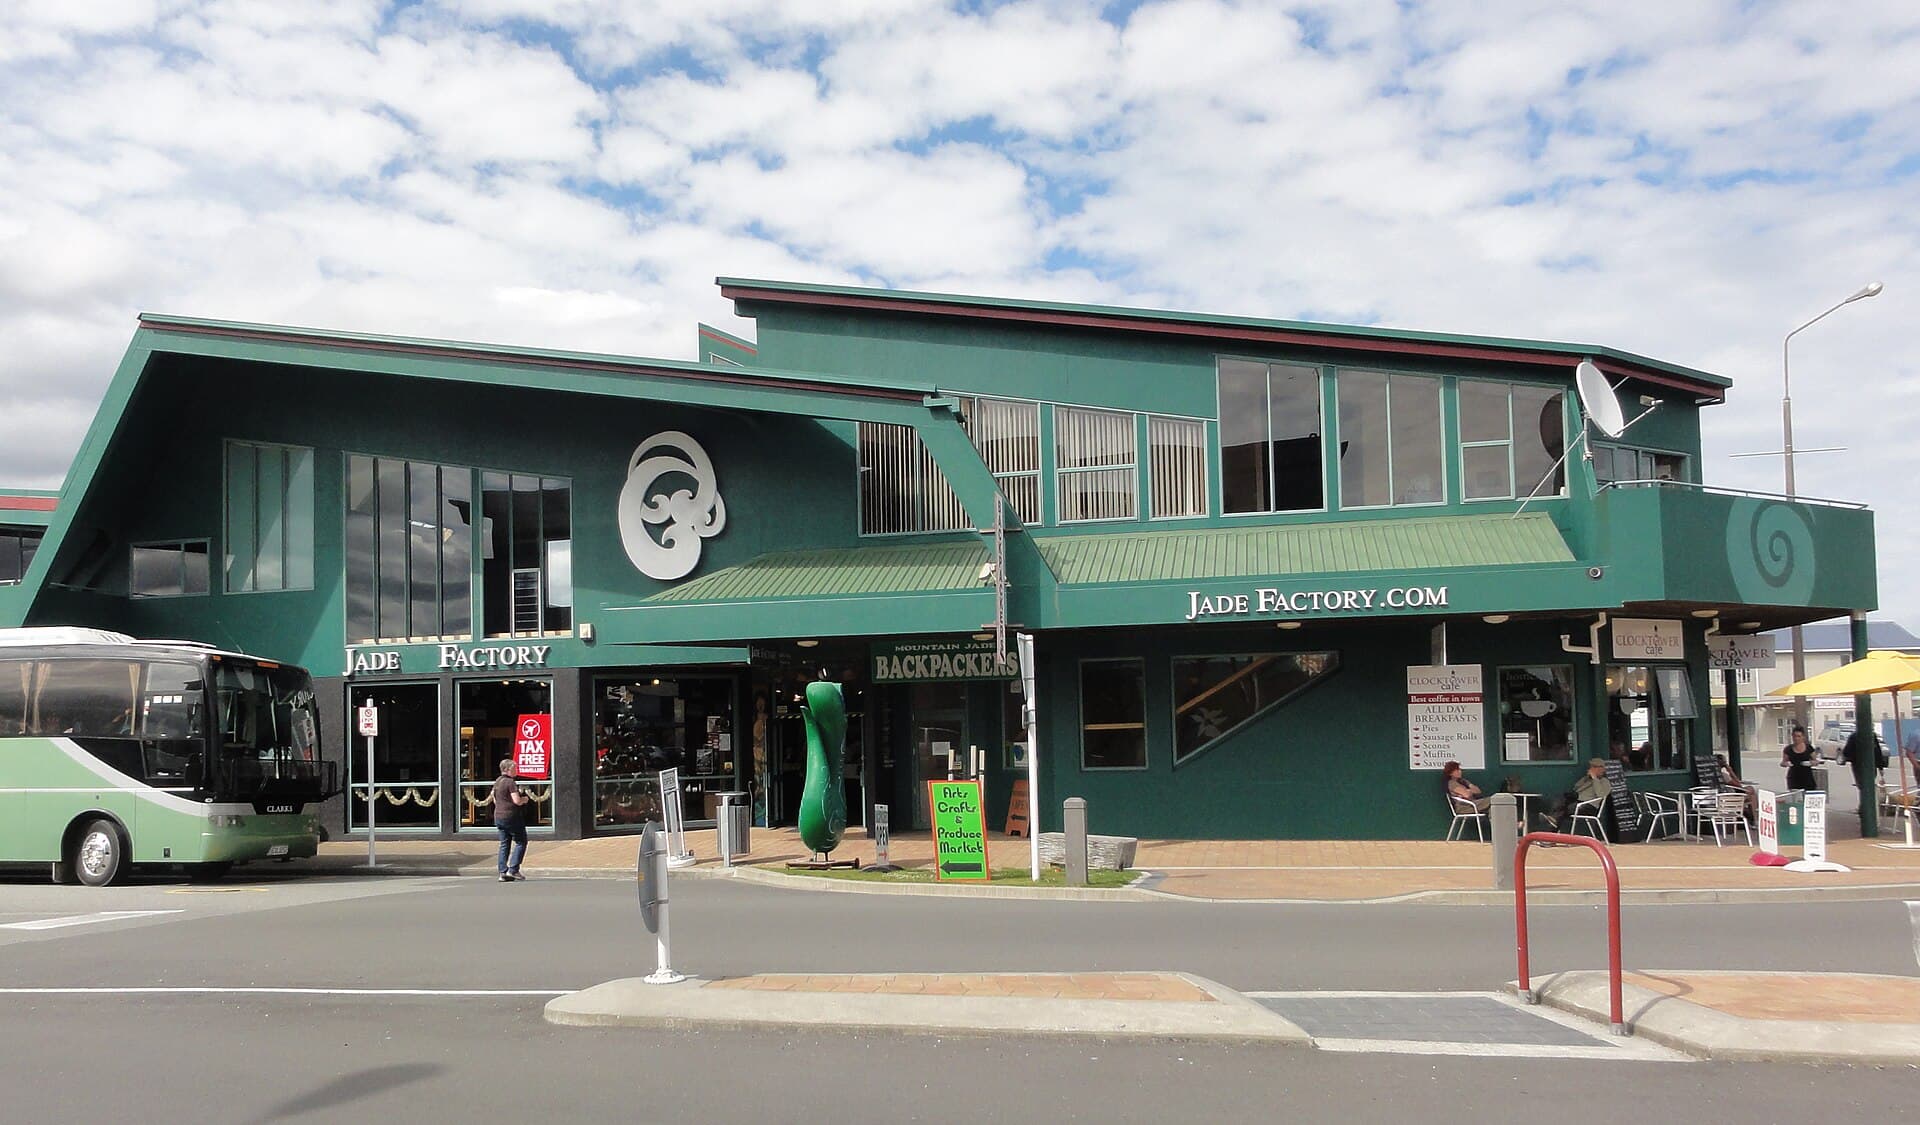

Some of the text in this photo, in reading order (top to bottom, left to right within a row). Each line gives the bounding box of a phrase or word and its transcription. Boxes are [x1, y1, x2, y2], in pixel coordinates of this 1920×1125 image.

[1185, 591, 1249, 620] JADE
[1615, 634, 1680, 647] CLOCKTOWER
[895, 642, 996, 652] MOUNTAIN JADE
[1710, 649, 1771, 659] KTOWER
[342, 644, 550, 676] JADE FACTORY
[875, 652, 1019, 679] BACKPACKERS
[1409, 676, 1479, 686] CLOCKTOWER
[1411, 695, 1427, 703] Best
[1428, 694, 1450, 703] coffee
[1451, 694, 1460, 702] in
[1425, 704, 1466, 714] ALL DAY
[1415, 713, 1478, 723] BREAKFASTS
[1422, 724, 1439, 732] Pies
[1422, 732, 1478, 742] Sausage Rolls
[518, 740, 545, 753] TAX
[1422, 741, 1451, 749] Scones
[518, 753, 545, 765] FREE
[1423, 750, 1456, 758] Muffins
[943, 786, 969, 799] Arts
[266, 805, 293, 813] CLARKS
[937, 801, 977, 813] Crafts
[955, 815, 963, 824] &
[937, 826, 982, 839] Produce
[1760, 817, 1776, 840] OPEN
[939, 841, 983, 854] Market
